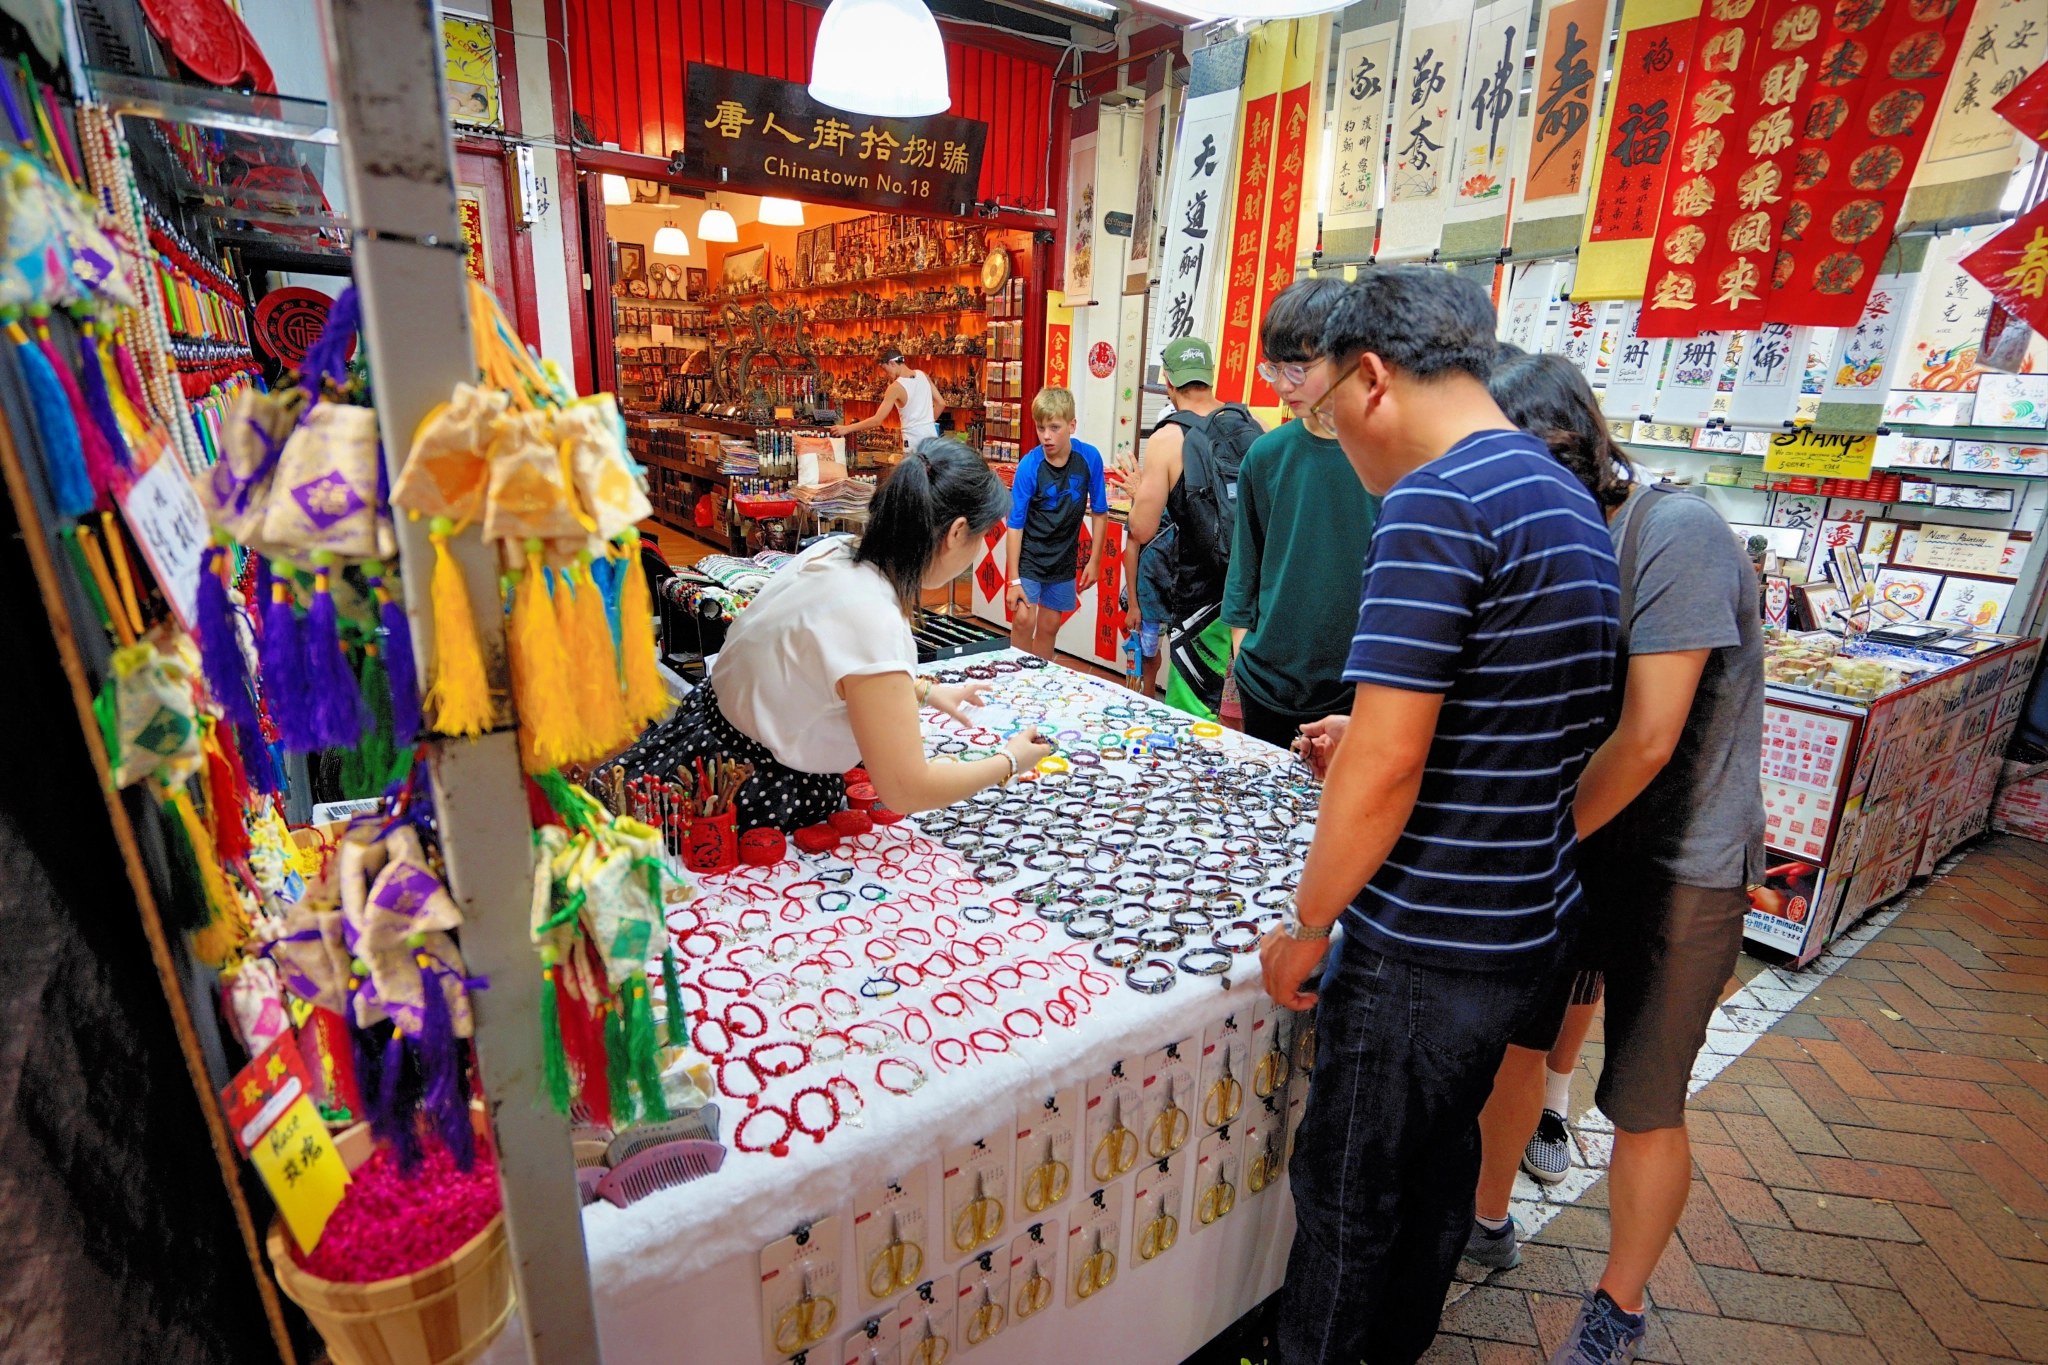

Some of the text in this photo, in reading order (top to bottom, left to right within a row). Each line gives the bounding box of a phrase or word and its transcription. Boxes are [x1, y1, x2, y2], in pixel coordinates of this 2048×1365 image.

[704, 100, 970, 176] 唐人街拾捌號
[1611, 99, 1671, 168] 福
[764, 156, 930, 199] Chinatown No.18
[288, 316, 325, 348] 福
[1925, 530, 1987, 544] Name Painting
[1763, 913, 1770, 922] in
[1776, 919, 1804, 933] minutes
[270, 1115, 301, 1157] Rose
